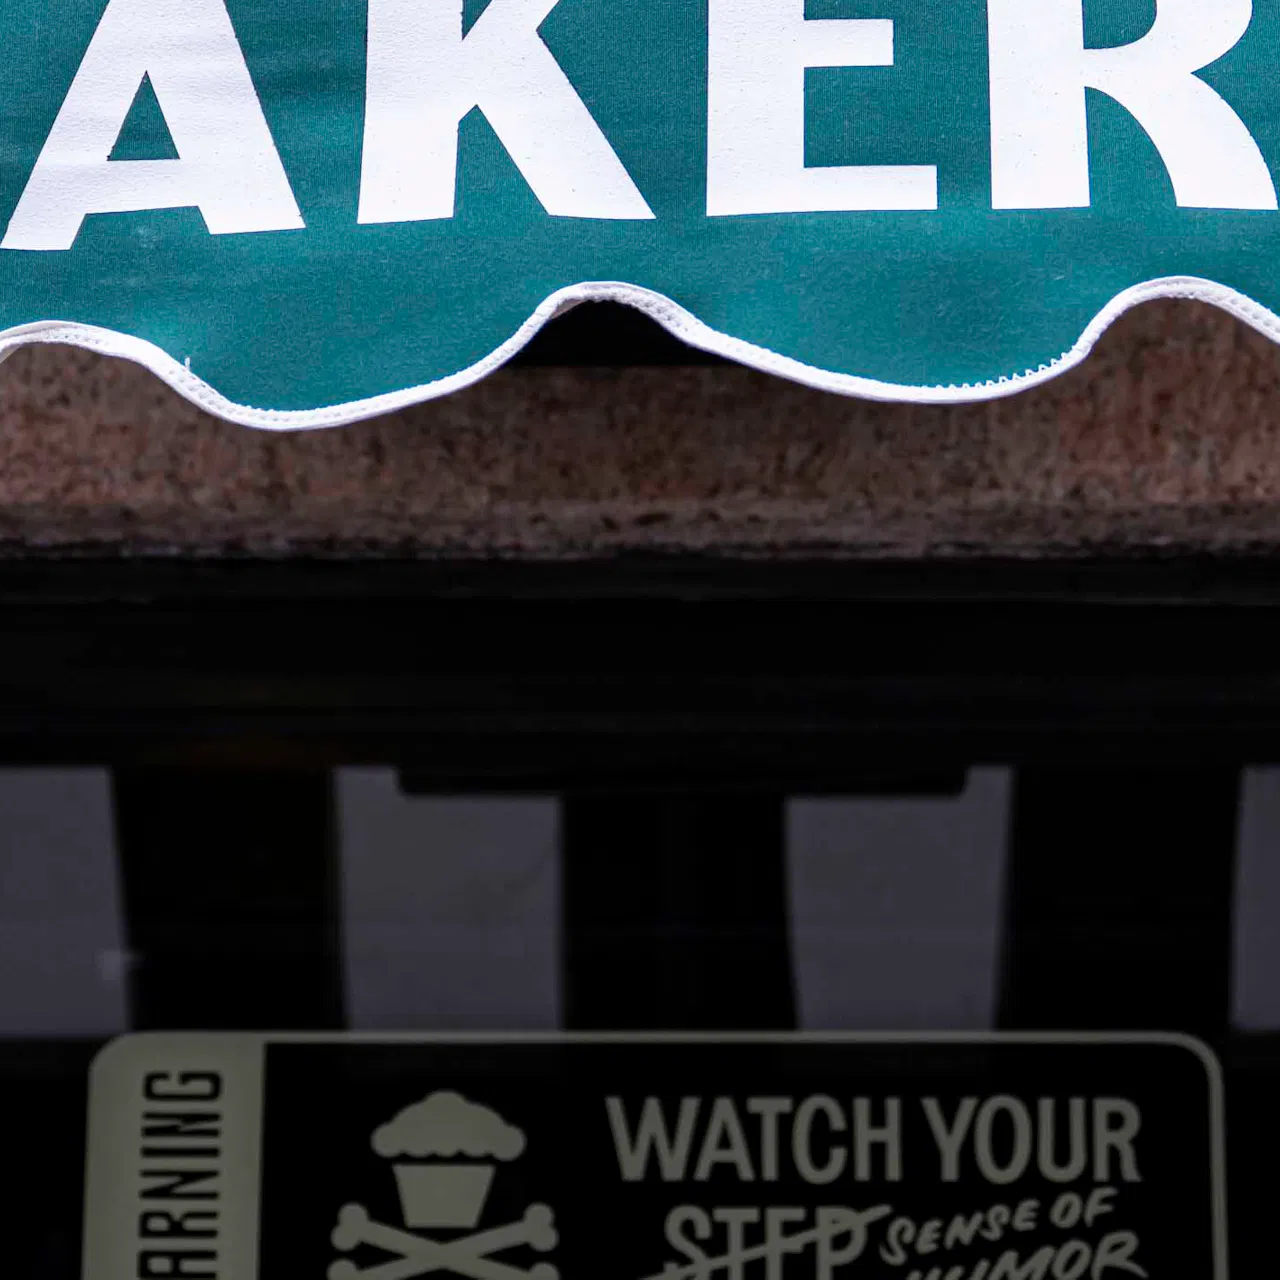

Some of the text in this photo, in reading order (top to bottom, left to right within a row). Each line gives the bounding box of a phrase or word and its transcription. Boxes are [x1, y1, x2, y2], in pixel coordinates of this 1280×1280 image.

[605, 1095, 1143, 1184] WATCH YOUR
[878, 1186, 1119, 1265] SENSE OF
[906, 1230, 1149, 1280] MOR
